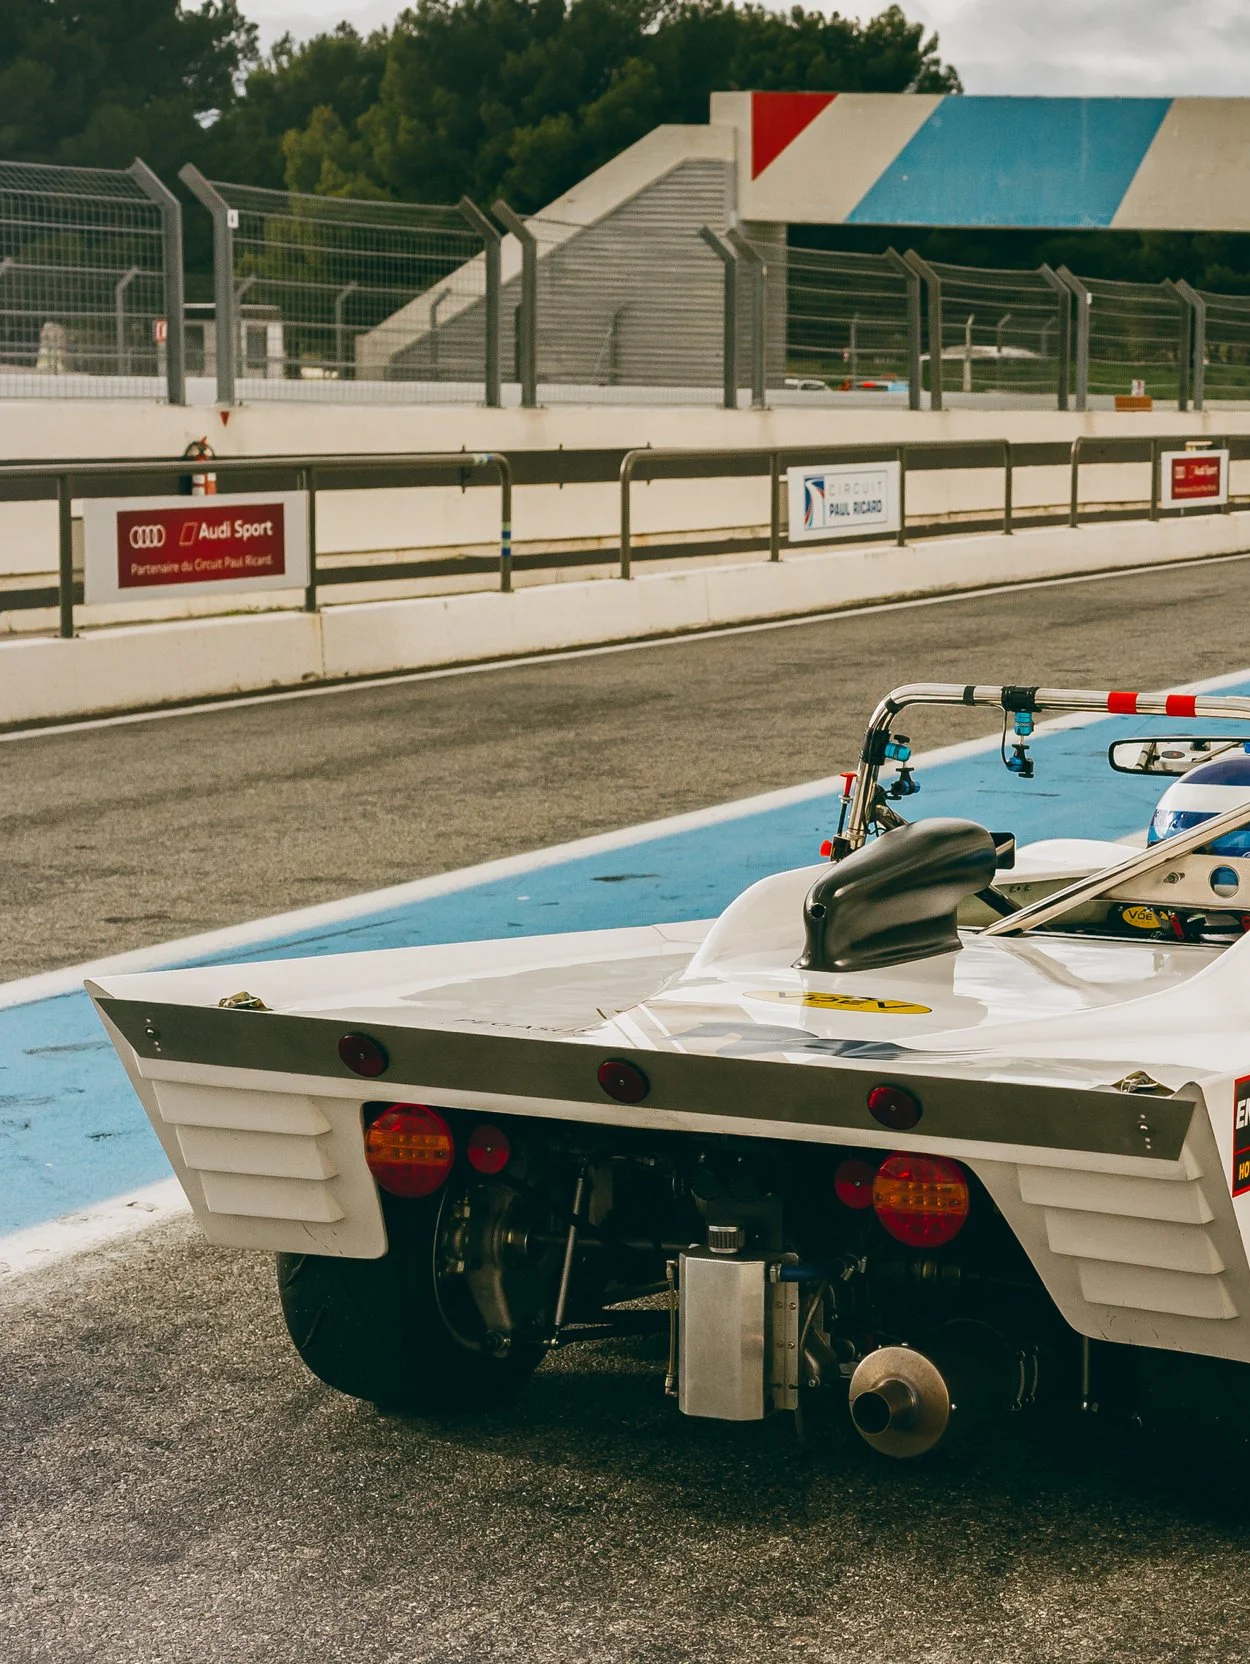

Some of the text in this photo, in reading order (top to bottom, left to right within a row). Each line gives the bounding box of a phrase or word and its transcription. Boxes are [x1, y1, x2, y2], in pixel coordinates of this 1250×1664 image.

[828, 481, 883, 497] CIRCUIT
[829, 499, 883, 516] PAUL RICARD
[198, 519, 273, 541] Audi Sport
[131, 561, 179, 576] Partenaire
[181, 559, 194, 572] du
[194, 558, 224, 571] Circuit
[224, 555, 244, 568] Paul
